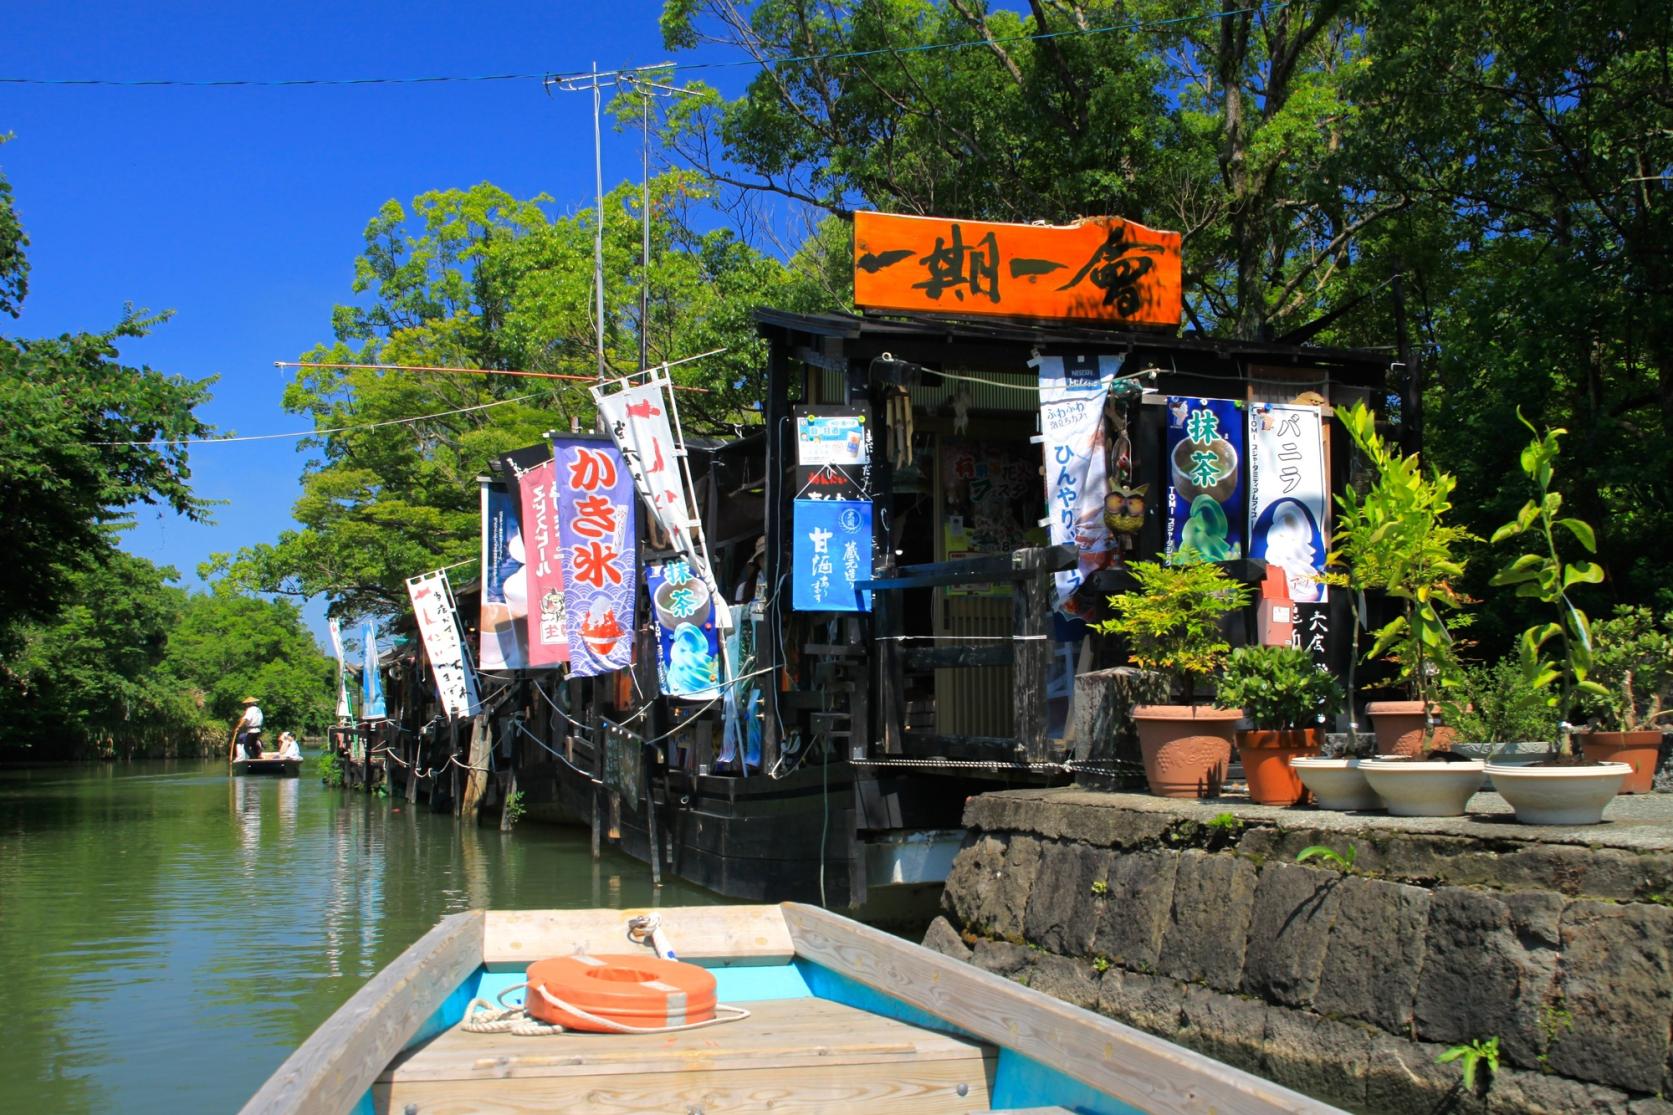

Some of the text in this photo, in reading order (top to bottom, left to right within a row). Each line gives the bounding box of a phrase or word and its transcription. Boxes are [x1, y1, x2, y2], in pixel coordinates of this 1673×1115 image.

[1187, 409, 1221, 488] 抹茶
[1276, 413, 1302, 494] バニラ
[569, 448, 623, 588] かき氷
[1168, 486, 1177, 515] TOMI
[663, 559, 696, 618] 抹茶
